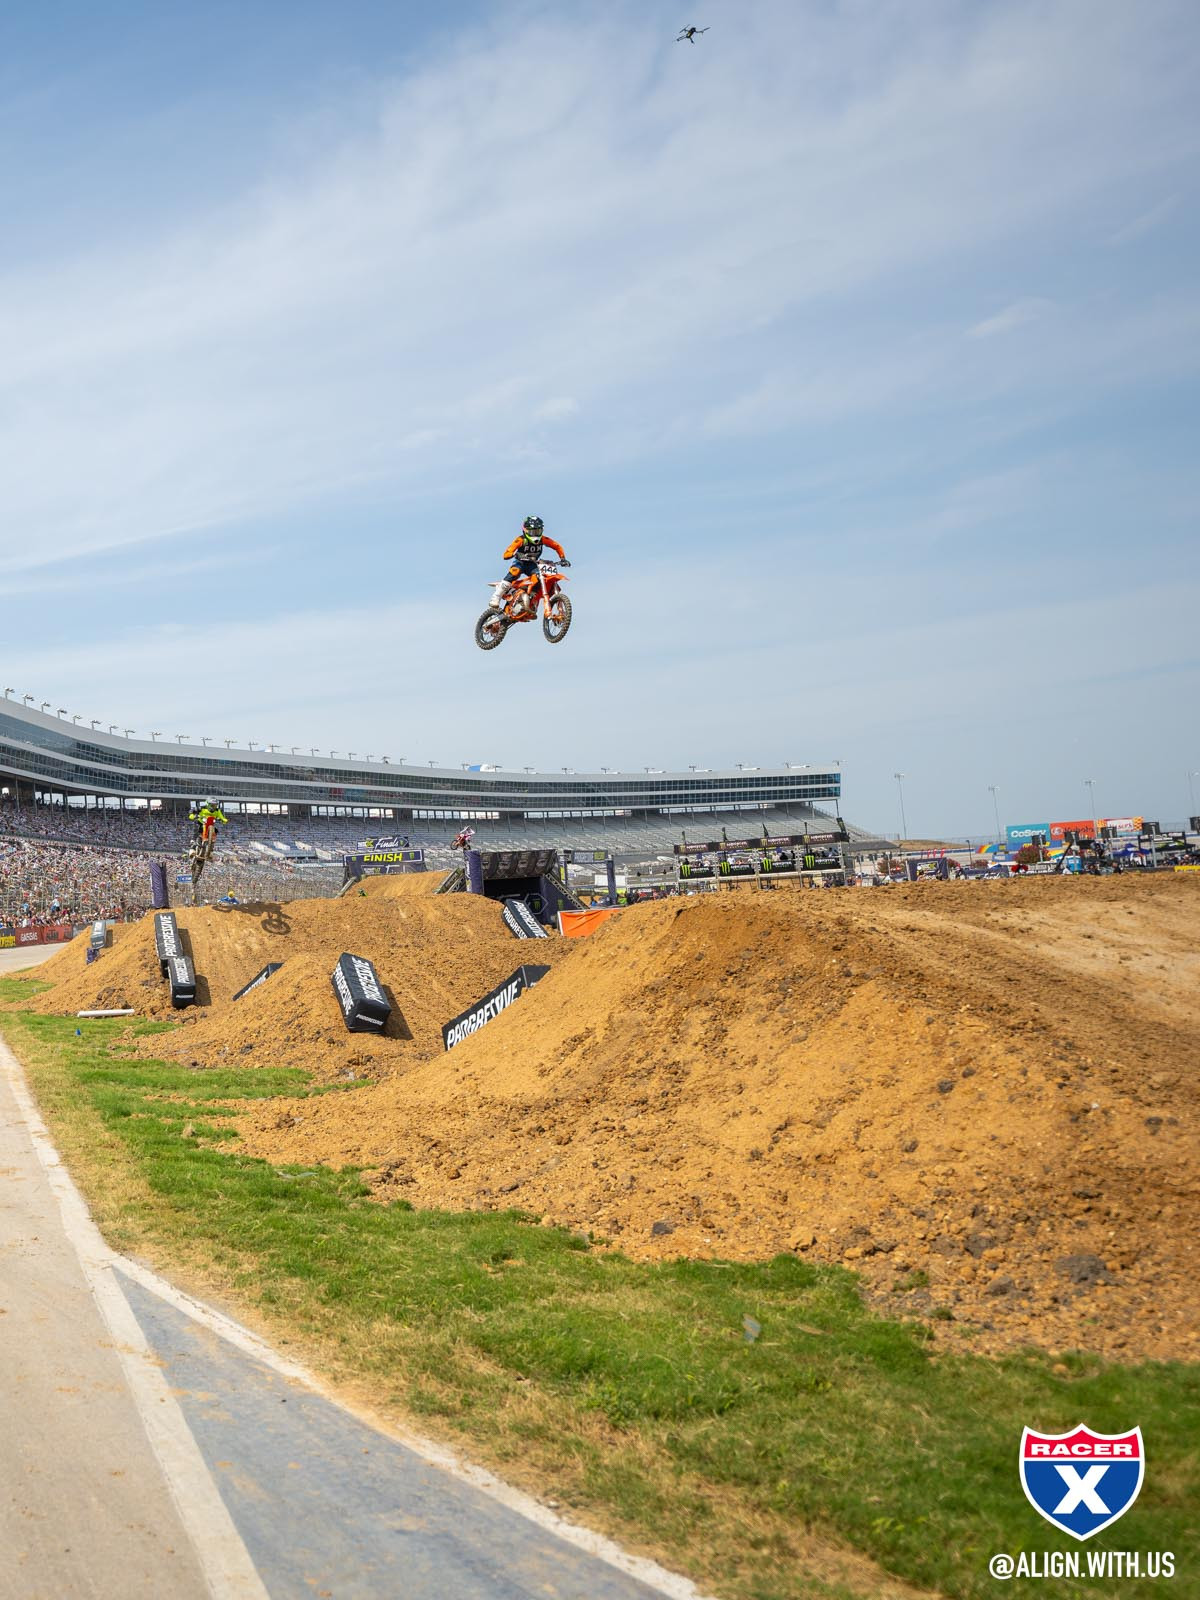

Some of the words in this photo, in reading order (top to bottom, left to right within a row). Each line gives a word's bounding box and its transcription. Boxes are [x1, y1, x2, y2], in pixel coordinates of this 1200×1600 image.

[541, 565, 558, 575] 444
[363, 852, 403, 862] FINISH
[159, 914, 178, 957] PROGRESSIVE
